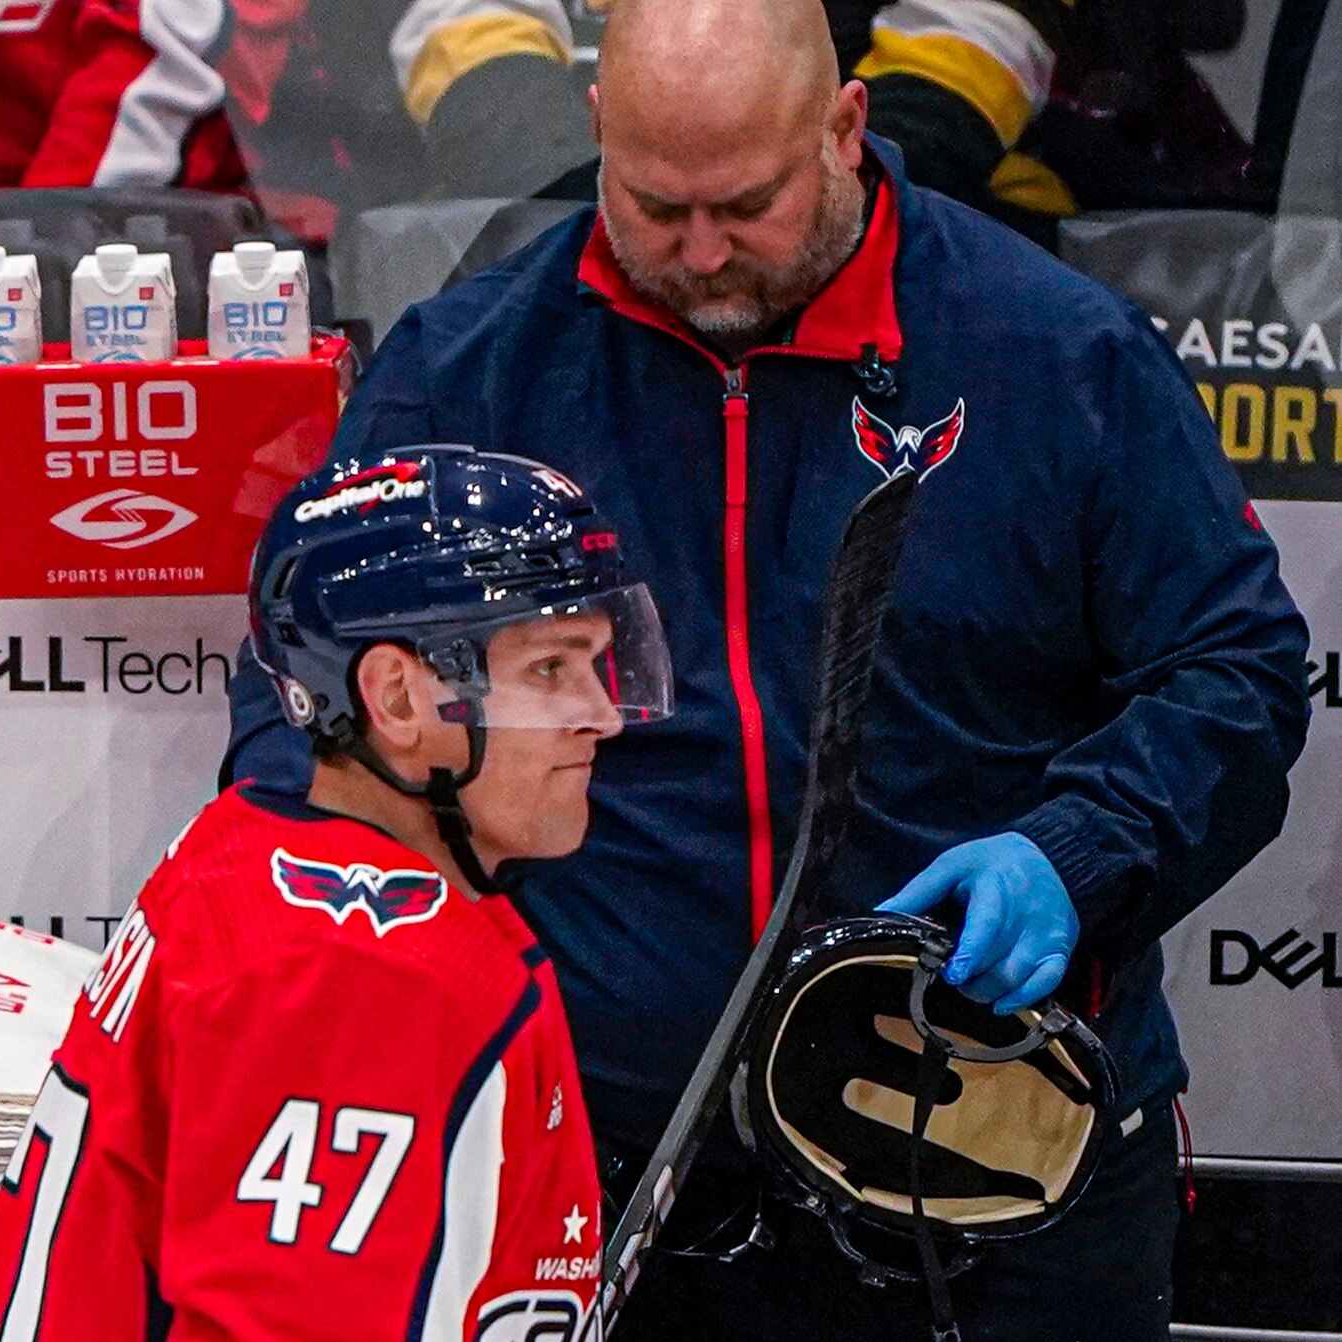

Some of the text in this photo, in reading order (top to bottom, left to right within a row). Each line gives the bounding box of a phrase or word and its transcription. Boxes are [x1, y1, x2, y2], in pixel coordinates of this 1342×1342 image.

[84, 305, 147, 331] BIO
[223, 301, 287, 327] BIO
[1151, 316, 1342, 371] AESA
[44, 380, 197, 442] BIO
[45, 449, 199, 478] STEEL
[47, 566, 204, 583] SPORTS HYDRATION
[236, 1097, 416, 1254] 47
[534, 1255, 601, 1281] WASH
